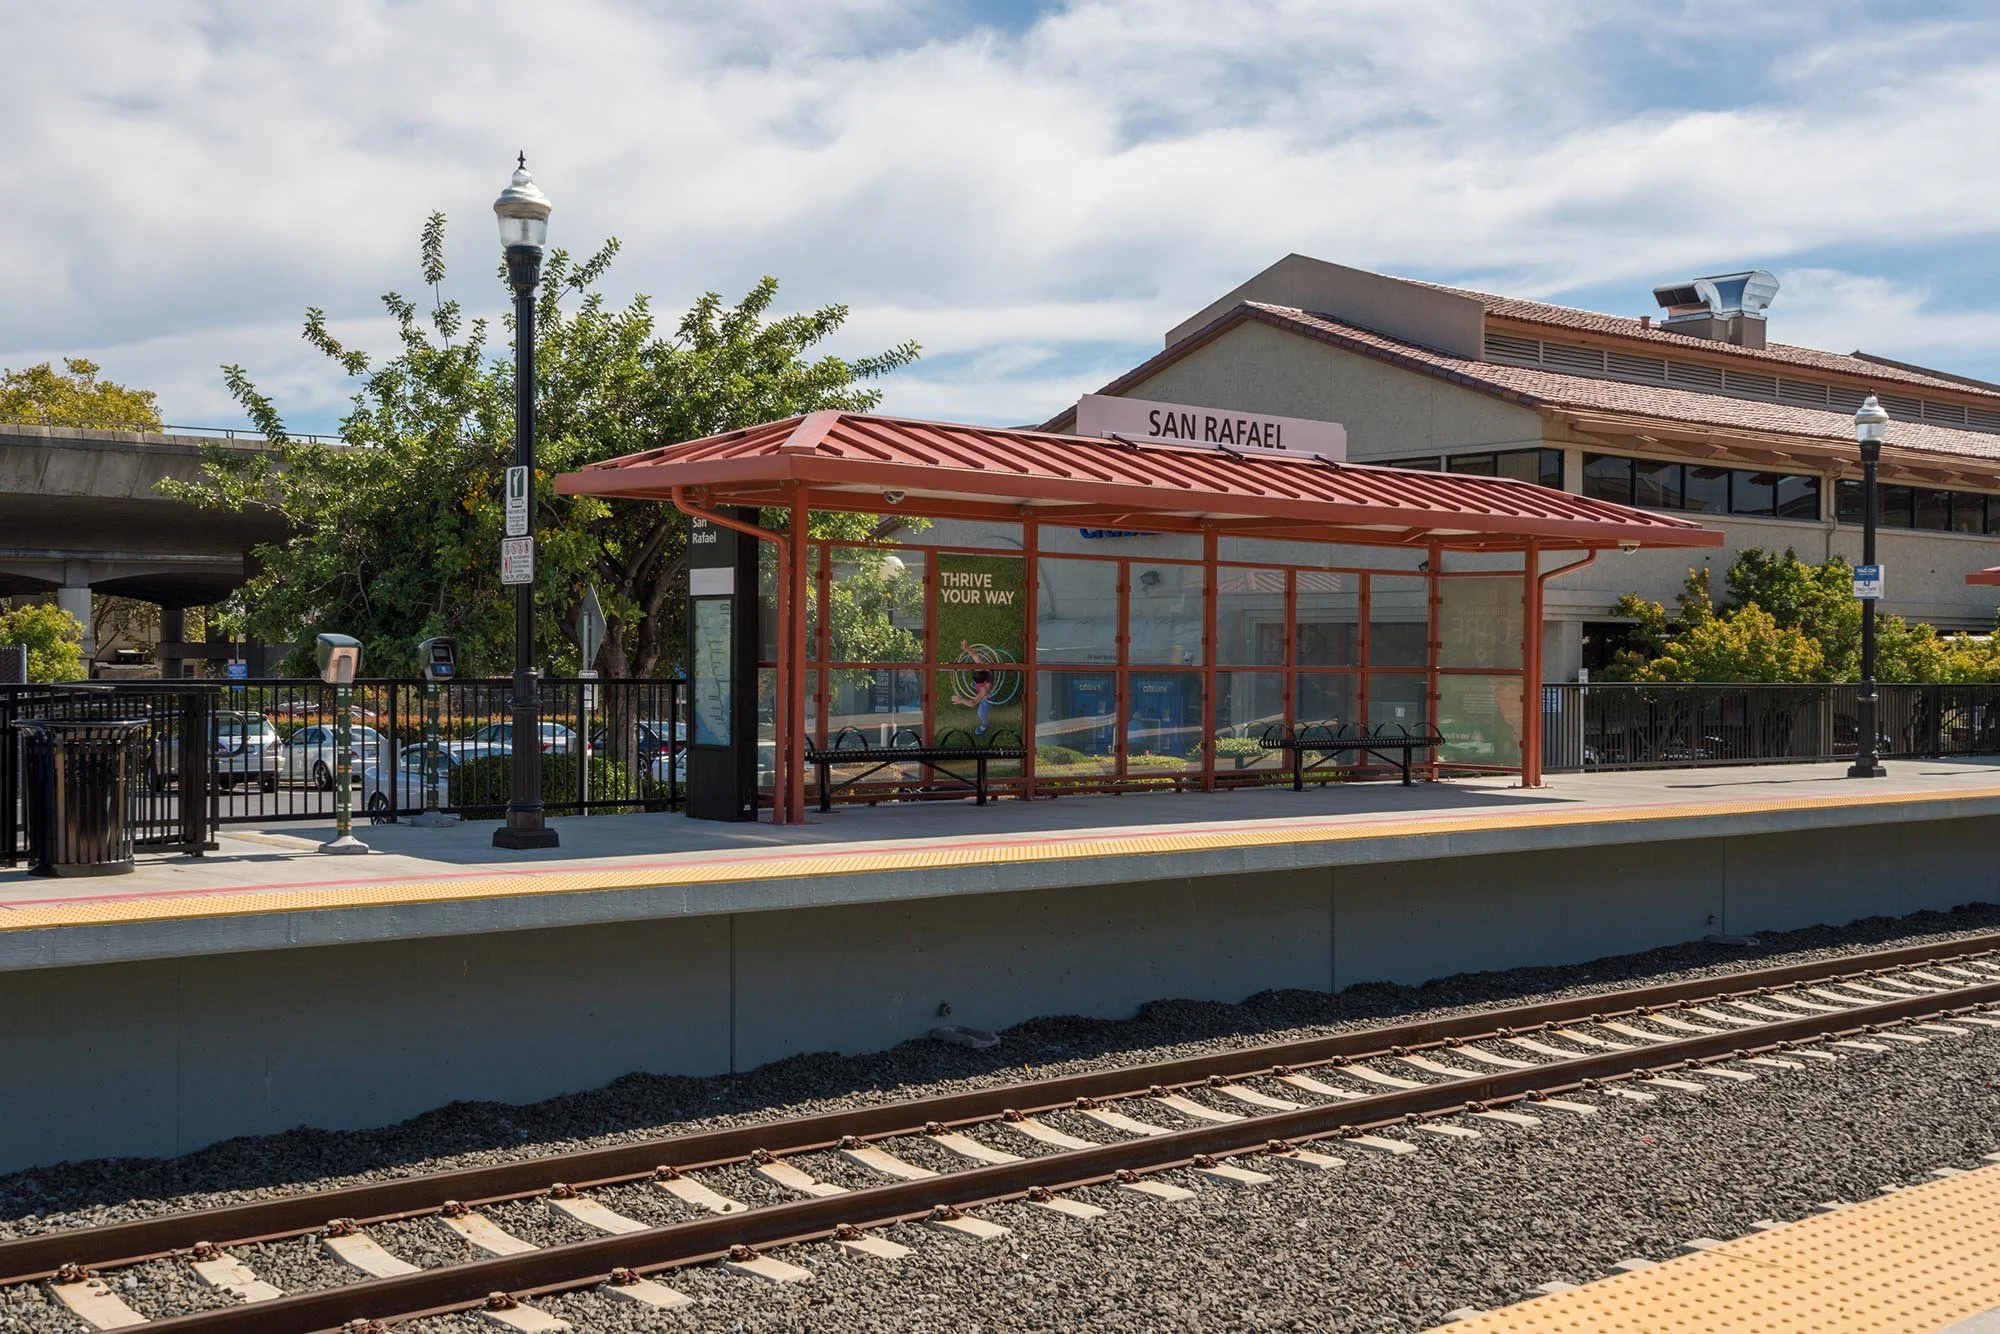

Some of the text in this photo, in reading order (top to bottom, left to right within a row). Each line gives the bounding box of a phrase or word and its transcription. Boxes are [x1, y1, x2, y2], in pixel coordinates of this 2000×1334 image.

[1149, 409, 1286, 450] SAN RAFAEL
[692, 516, 707, 528] San
[692, 530, 717, 544] Rafael
[941, 572, 992, 588] THRIVE
[941, 588, 1015, 605] YOUR WAY
